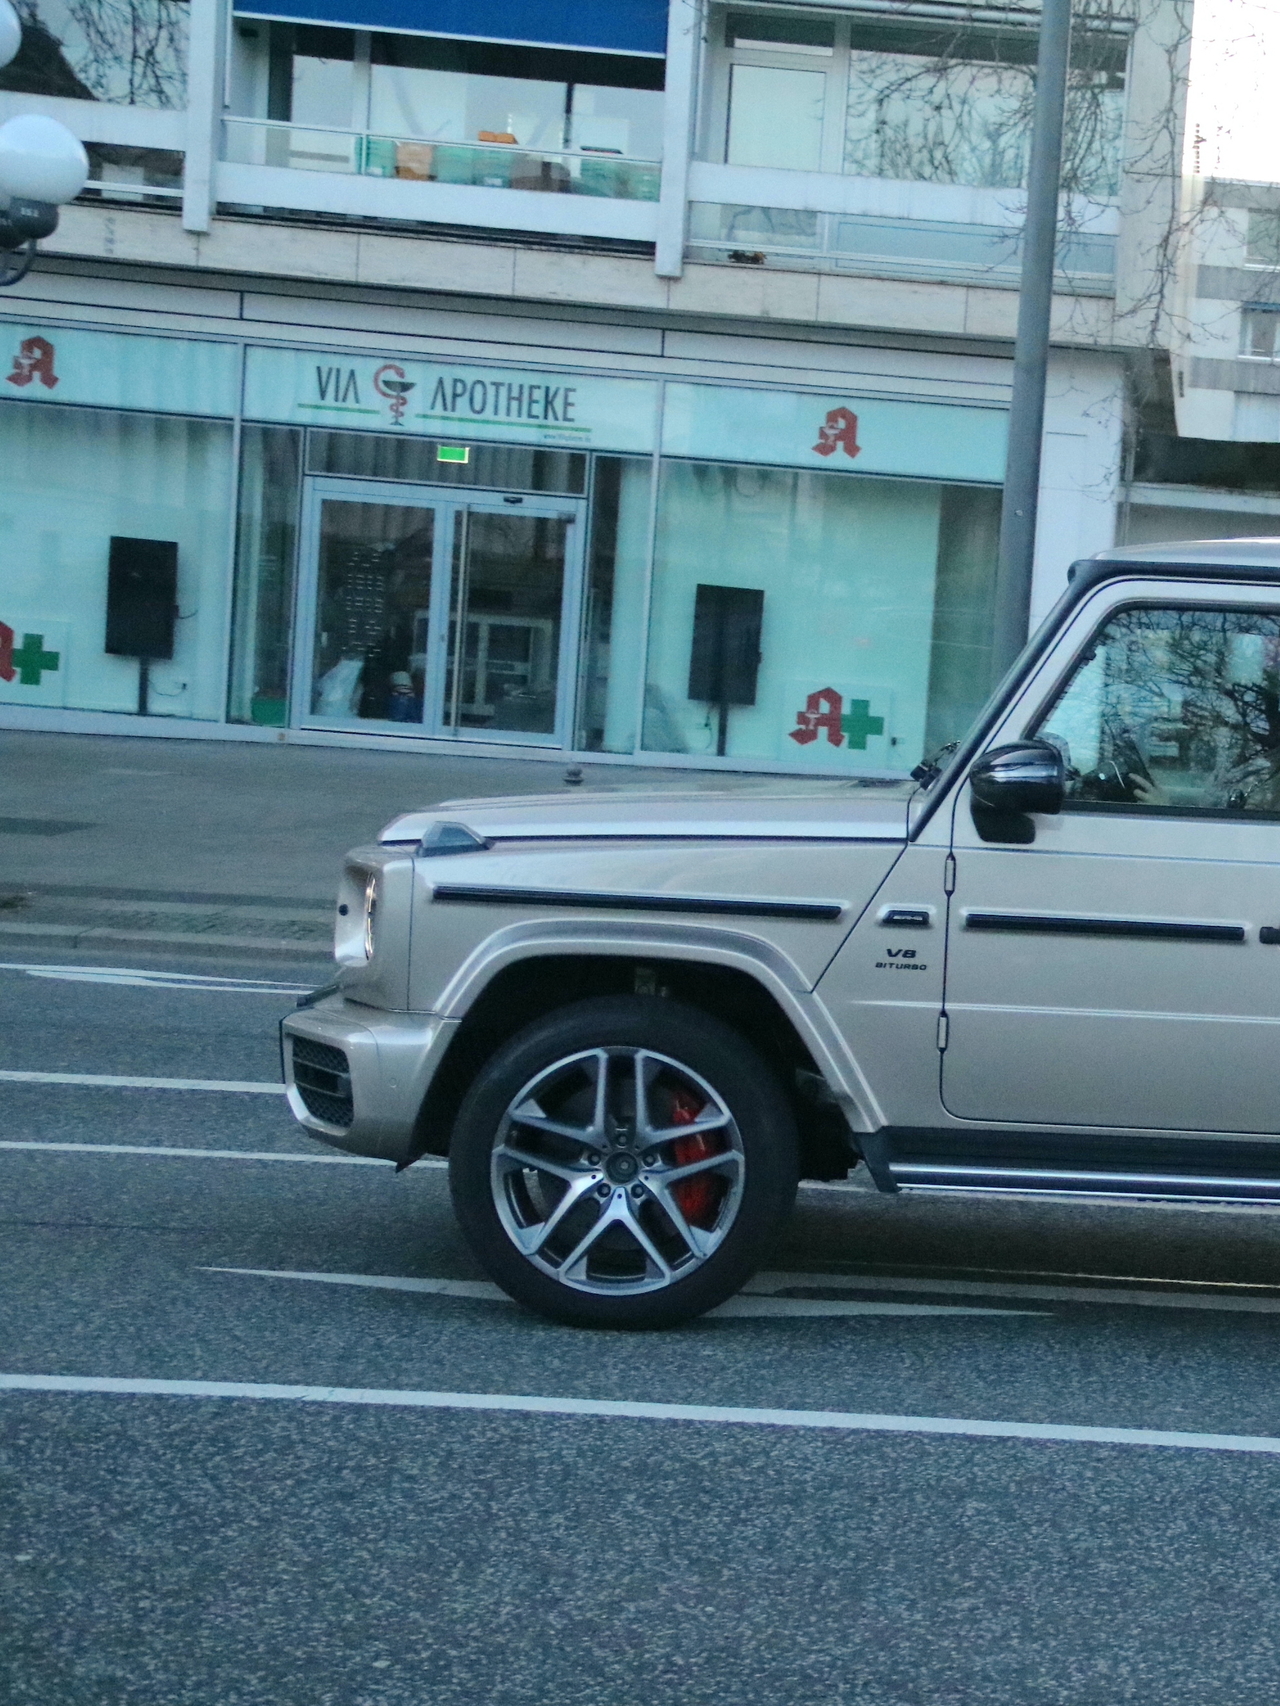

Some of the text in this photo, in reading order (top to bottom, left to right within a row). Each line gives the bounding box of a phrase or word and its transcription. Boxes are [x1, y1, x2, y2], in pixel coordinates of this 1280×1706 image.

[316, 366, 577, 422] VIA APOTHEKE
[886, 948, 917, 959] V8
[875, 962, 927, 971] BITURBO
